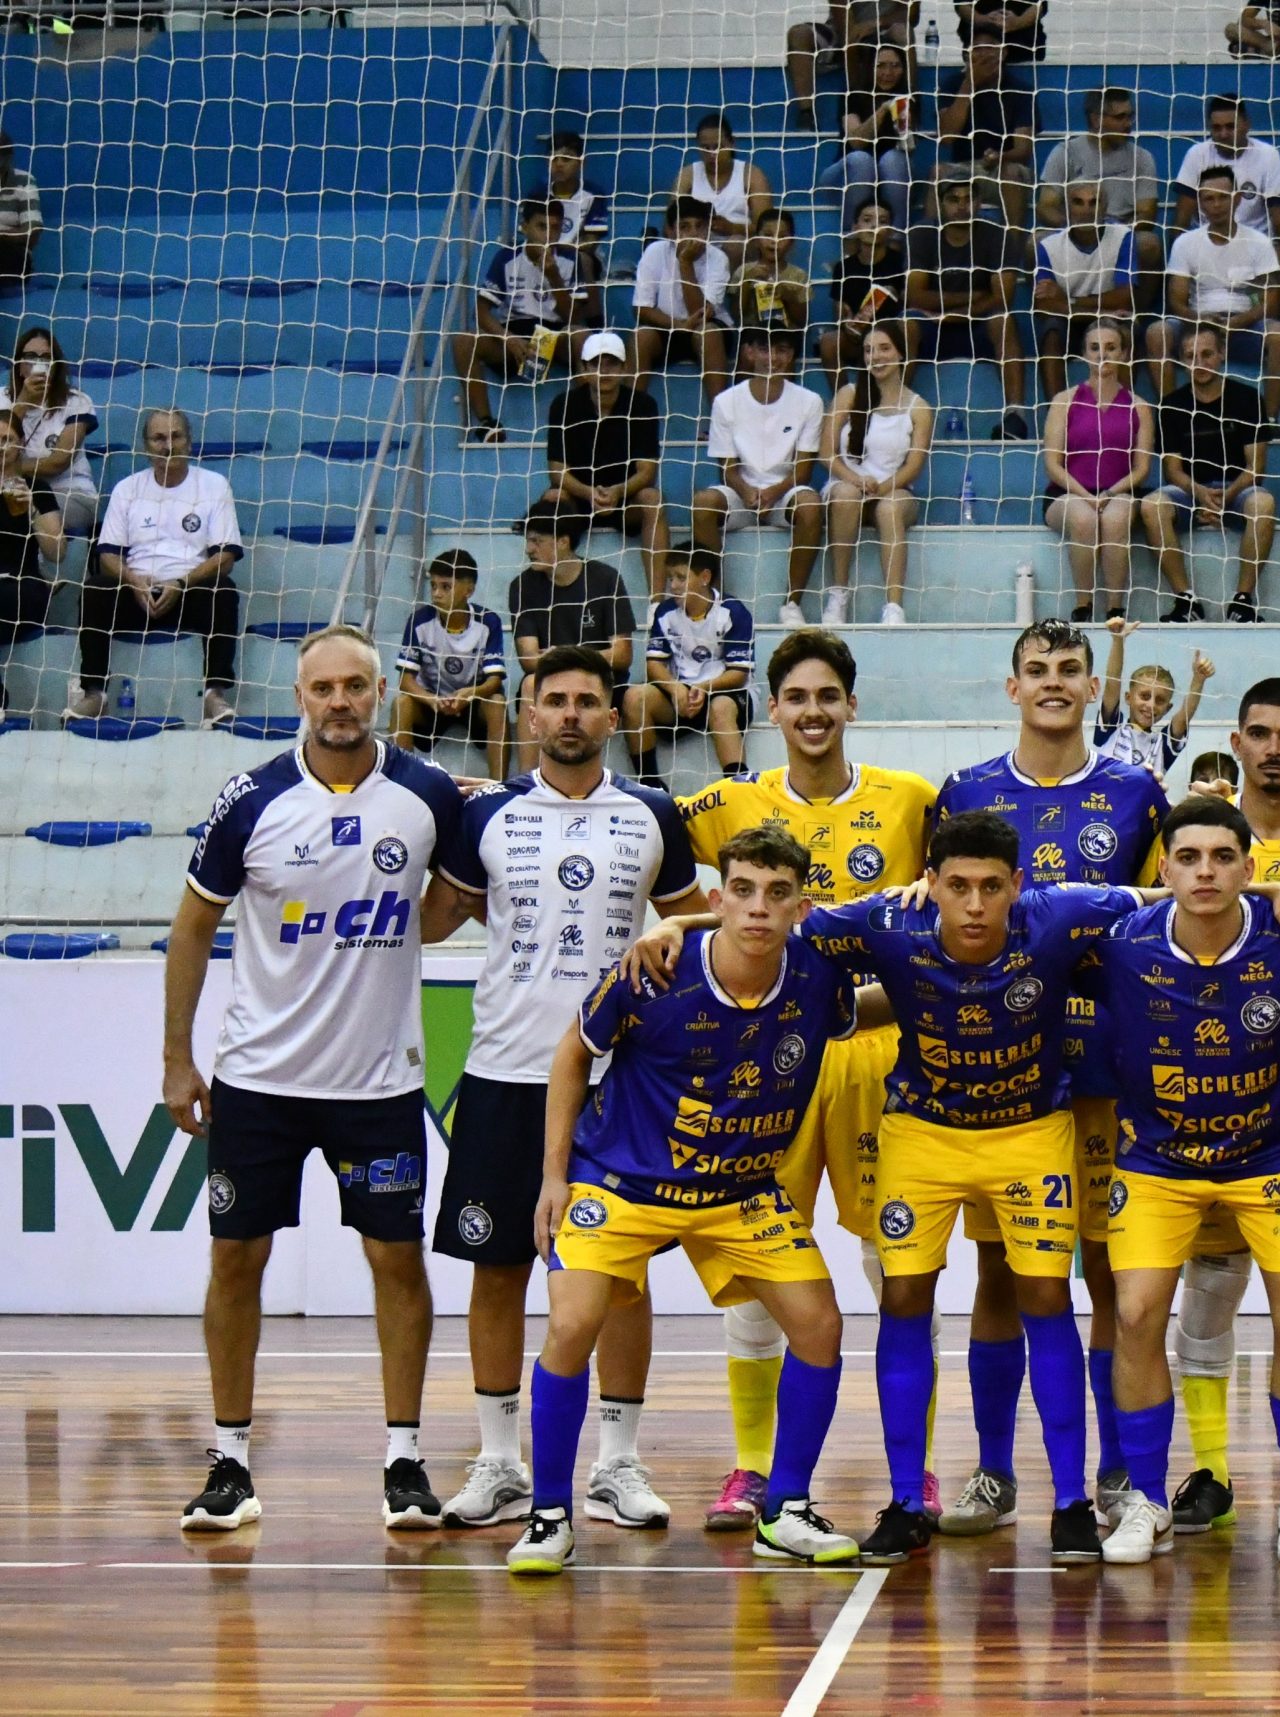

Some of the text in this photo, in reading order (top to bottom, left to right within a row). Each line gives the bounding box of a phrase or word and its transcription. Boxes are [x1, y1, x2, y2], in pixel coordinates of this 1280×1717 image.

[218, 781, 259, 822] FUTSAL
[984, 803, 1018, 812] CRIATIVA
[1081, 800, 1113, 811] MEGA
[850, 820, 882, 829] MEGA
[334, 890, 411, 937] ch
[884, 905, 893, 929] LNF
[334, 937, 404, 950] sistemas
[1003, 955, 1033, 973] MEGA
[641, 976, 656, 999] LNF
[1239, 970, 1274, 982] MEGA
[685, 1022, 720, 1031] CRIATIVA
[951, 1033, 1042, 1066] SCHERER
[1186, 1062, 1278, 1095] SCHERER
[369, 1152, 420, 1185] ch
[693, 1150, 784, 1175] SICOOB
[1042, 1174, 1073, 1209] 21
[1010, 1213, 1039, 1227] AABB
